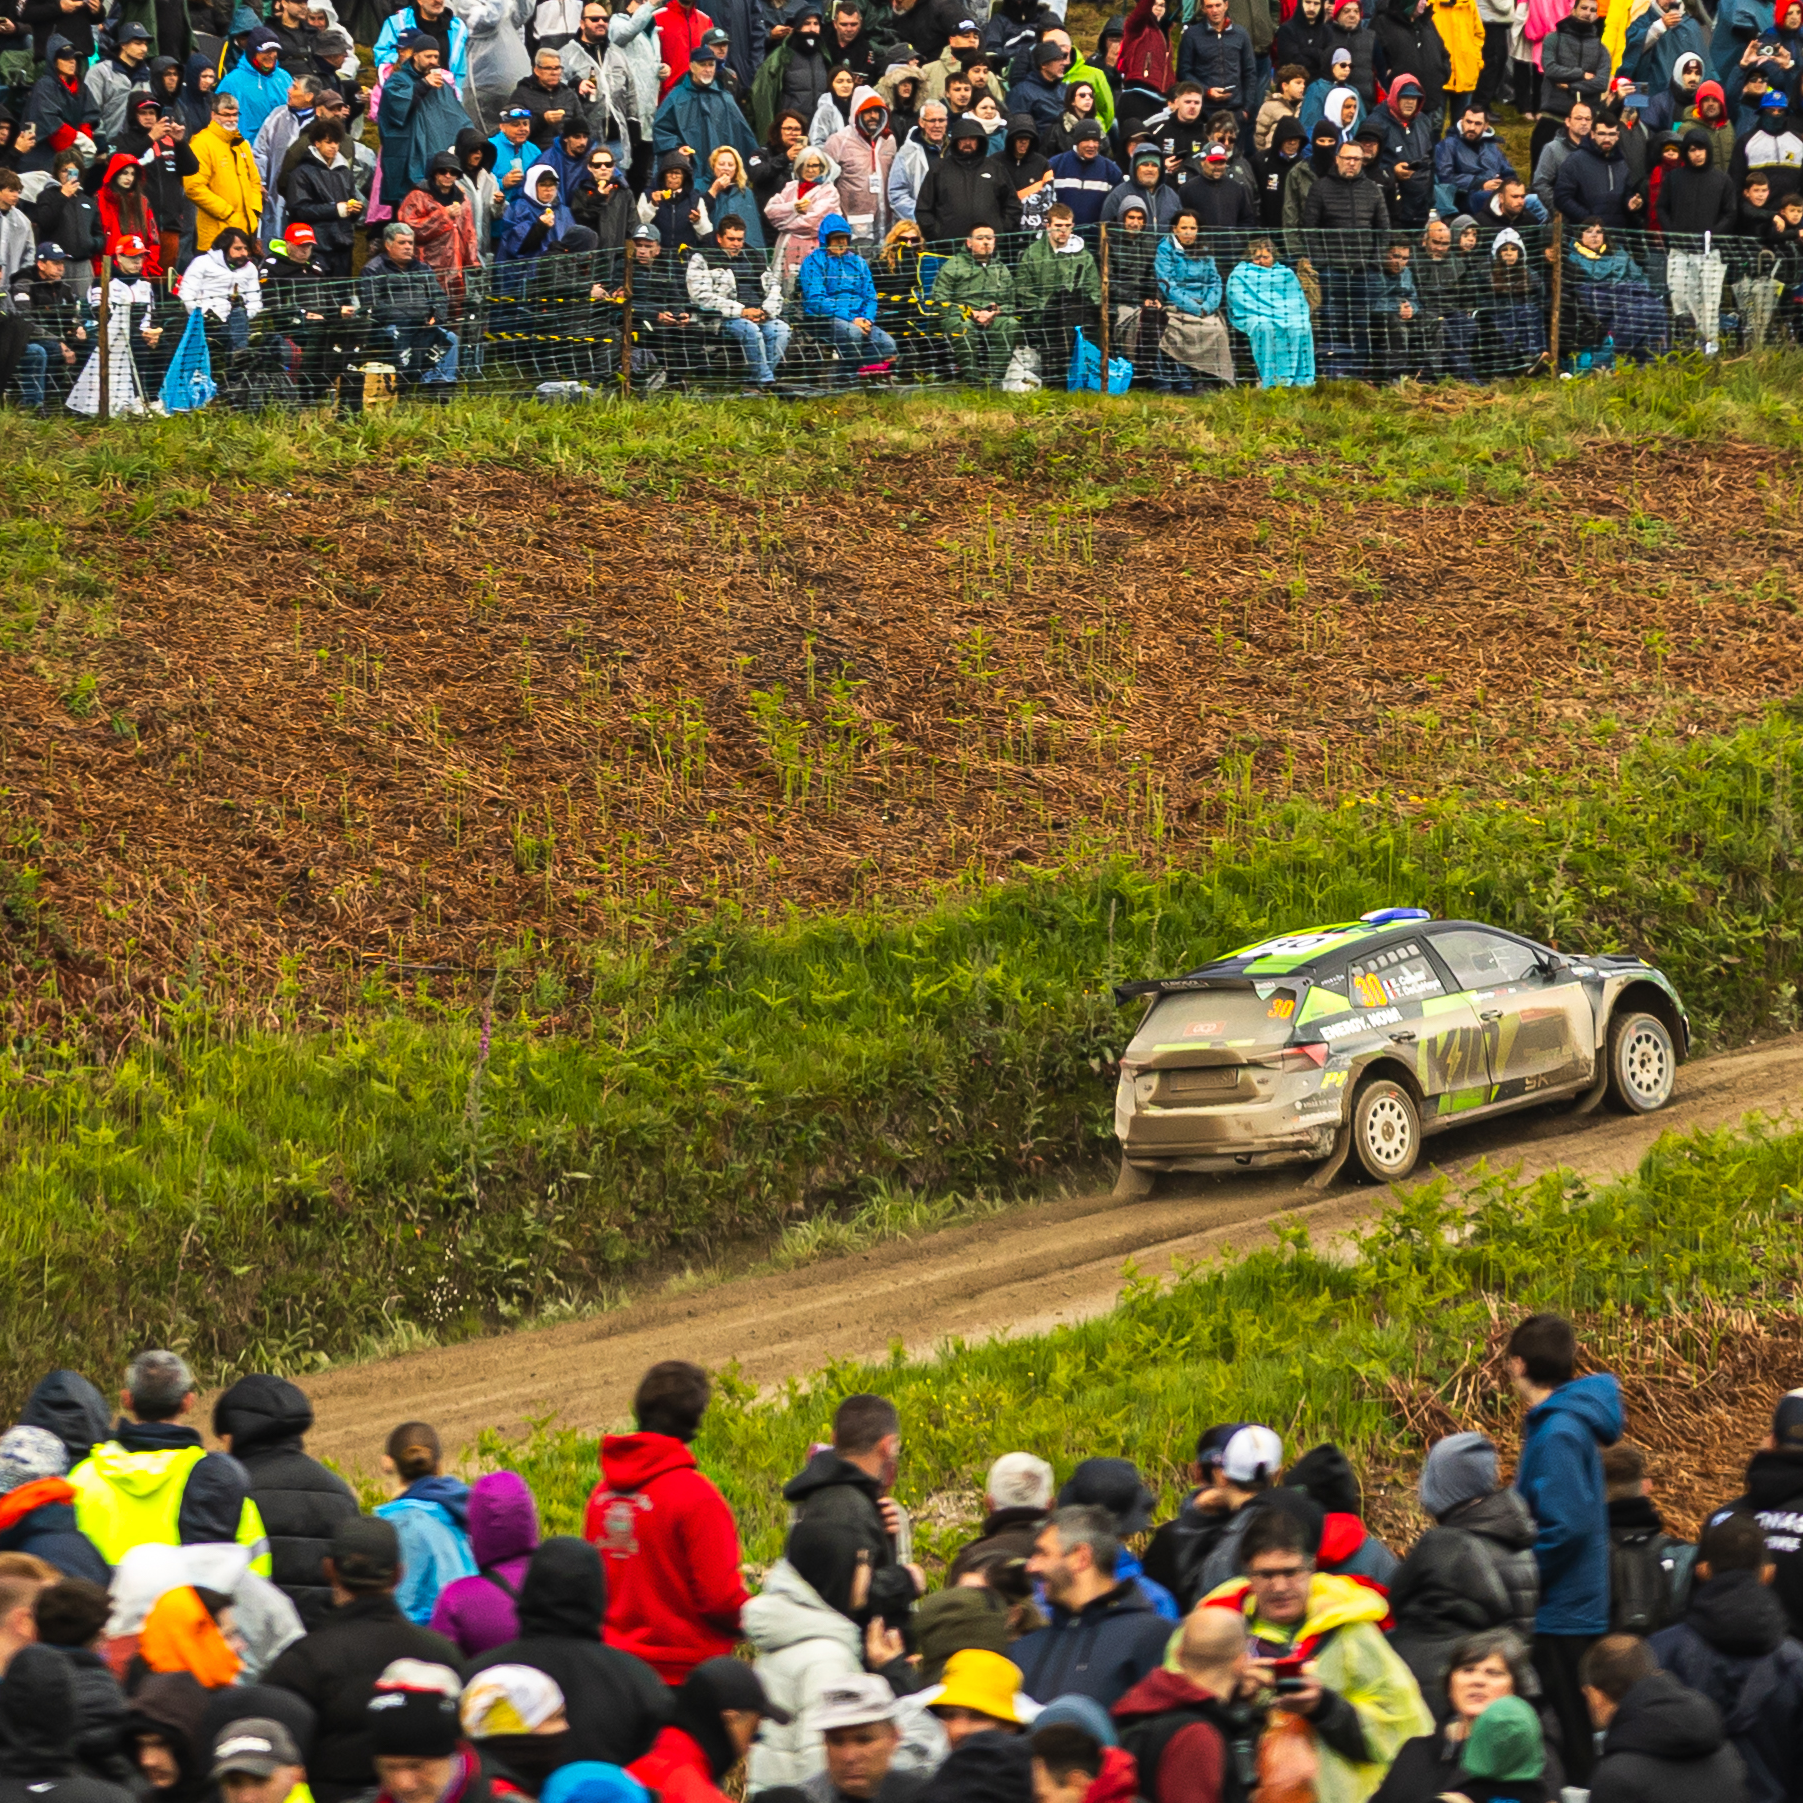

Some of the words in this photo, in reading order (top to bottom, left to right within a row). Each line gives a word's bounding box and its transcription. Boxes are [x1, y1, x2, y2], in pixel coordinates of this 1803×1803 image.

[1353, 972, 1389, 1008] 30
[1267, 998, 1296, 1020] 30
[1366, 1006, 1404, 1029] NOW!
